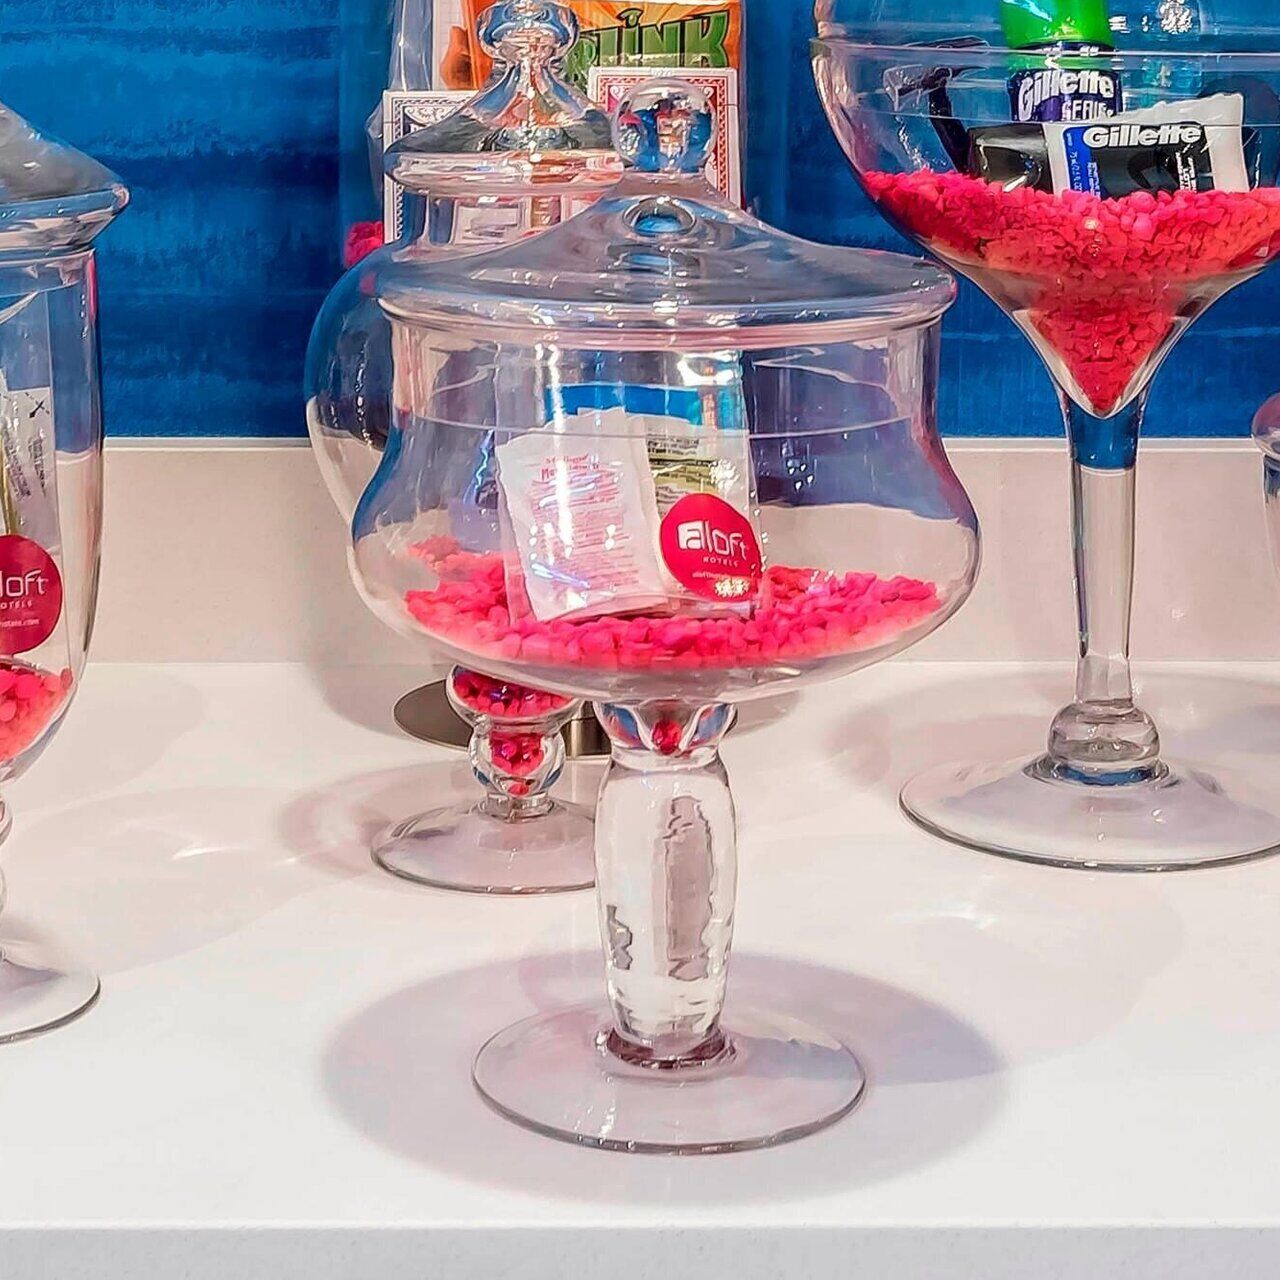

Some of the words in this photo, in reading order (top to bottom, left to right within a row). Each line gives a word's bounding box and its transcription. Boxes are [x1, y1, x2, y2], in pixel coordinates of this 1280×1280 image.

[1018, 70, 1115, 121] Gillette
[1082, 125, 1202, 149] Gillette
[677, 519, 748, 561] aloft
